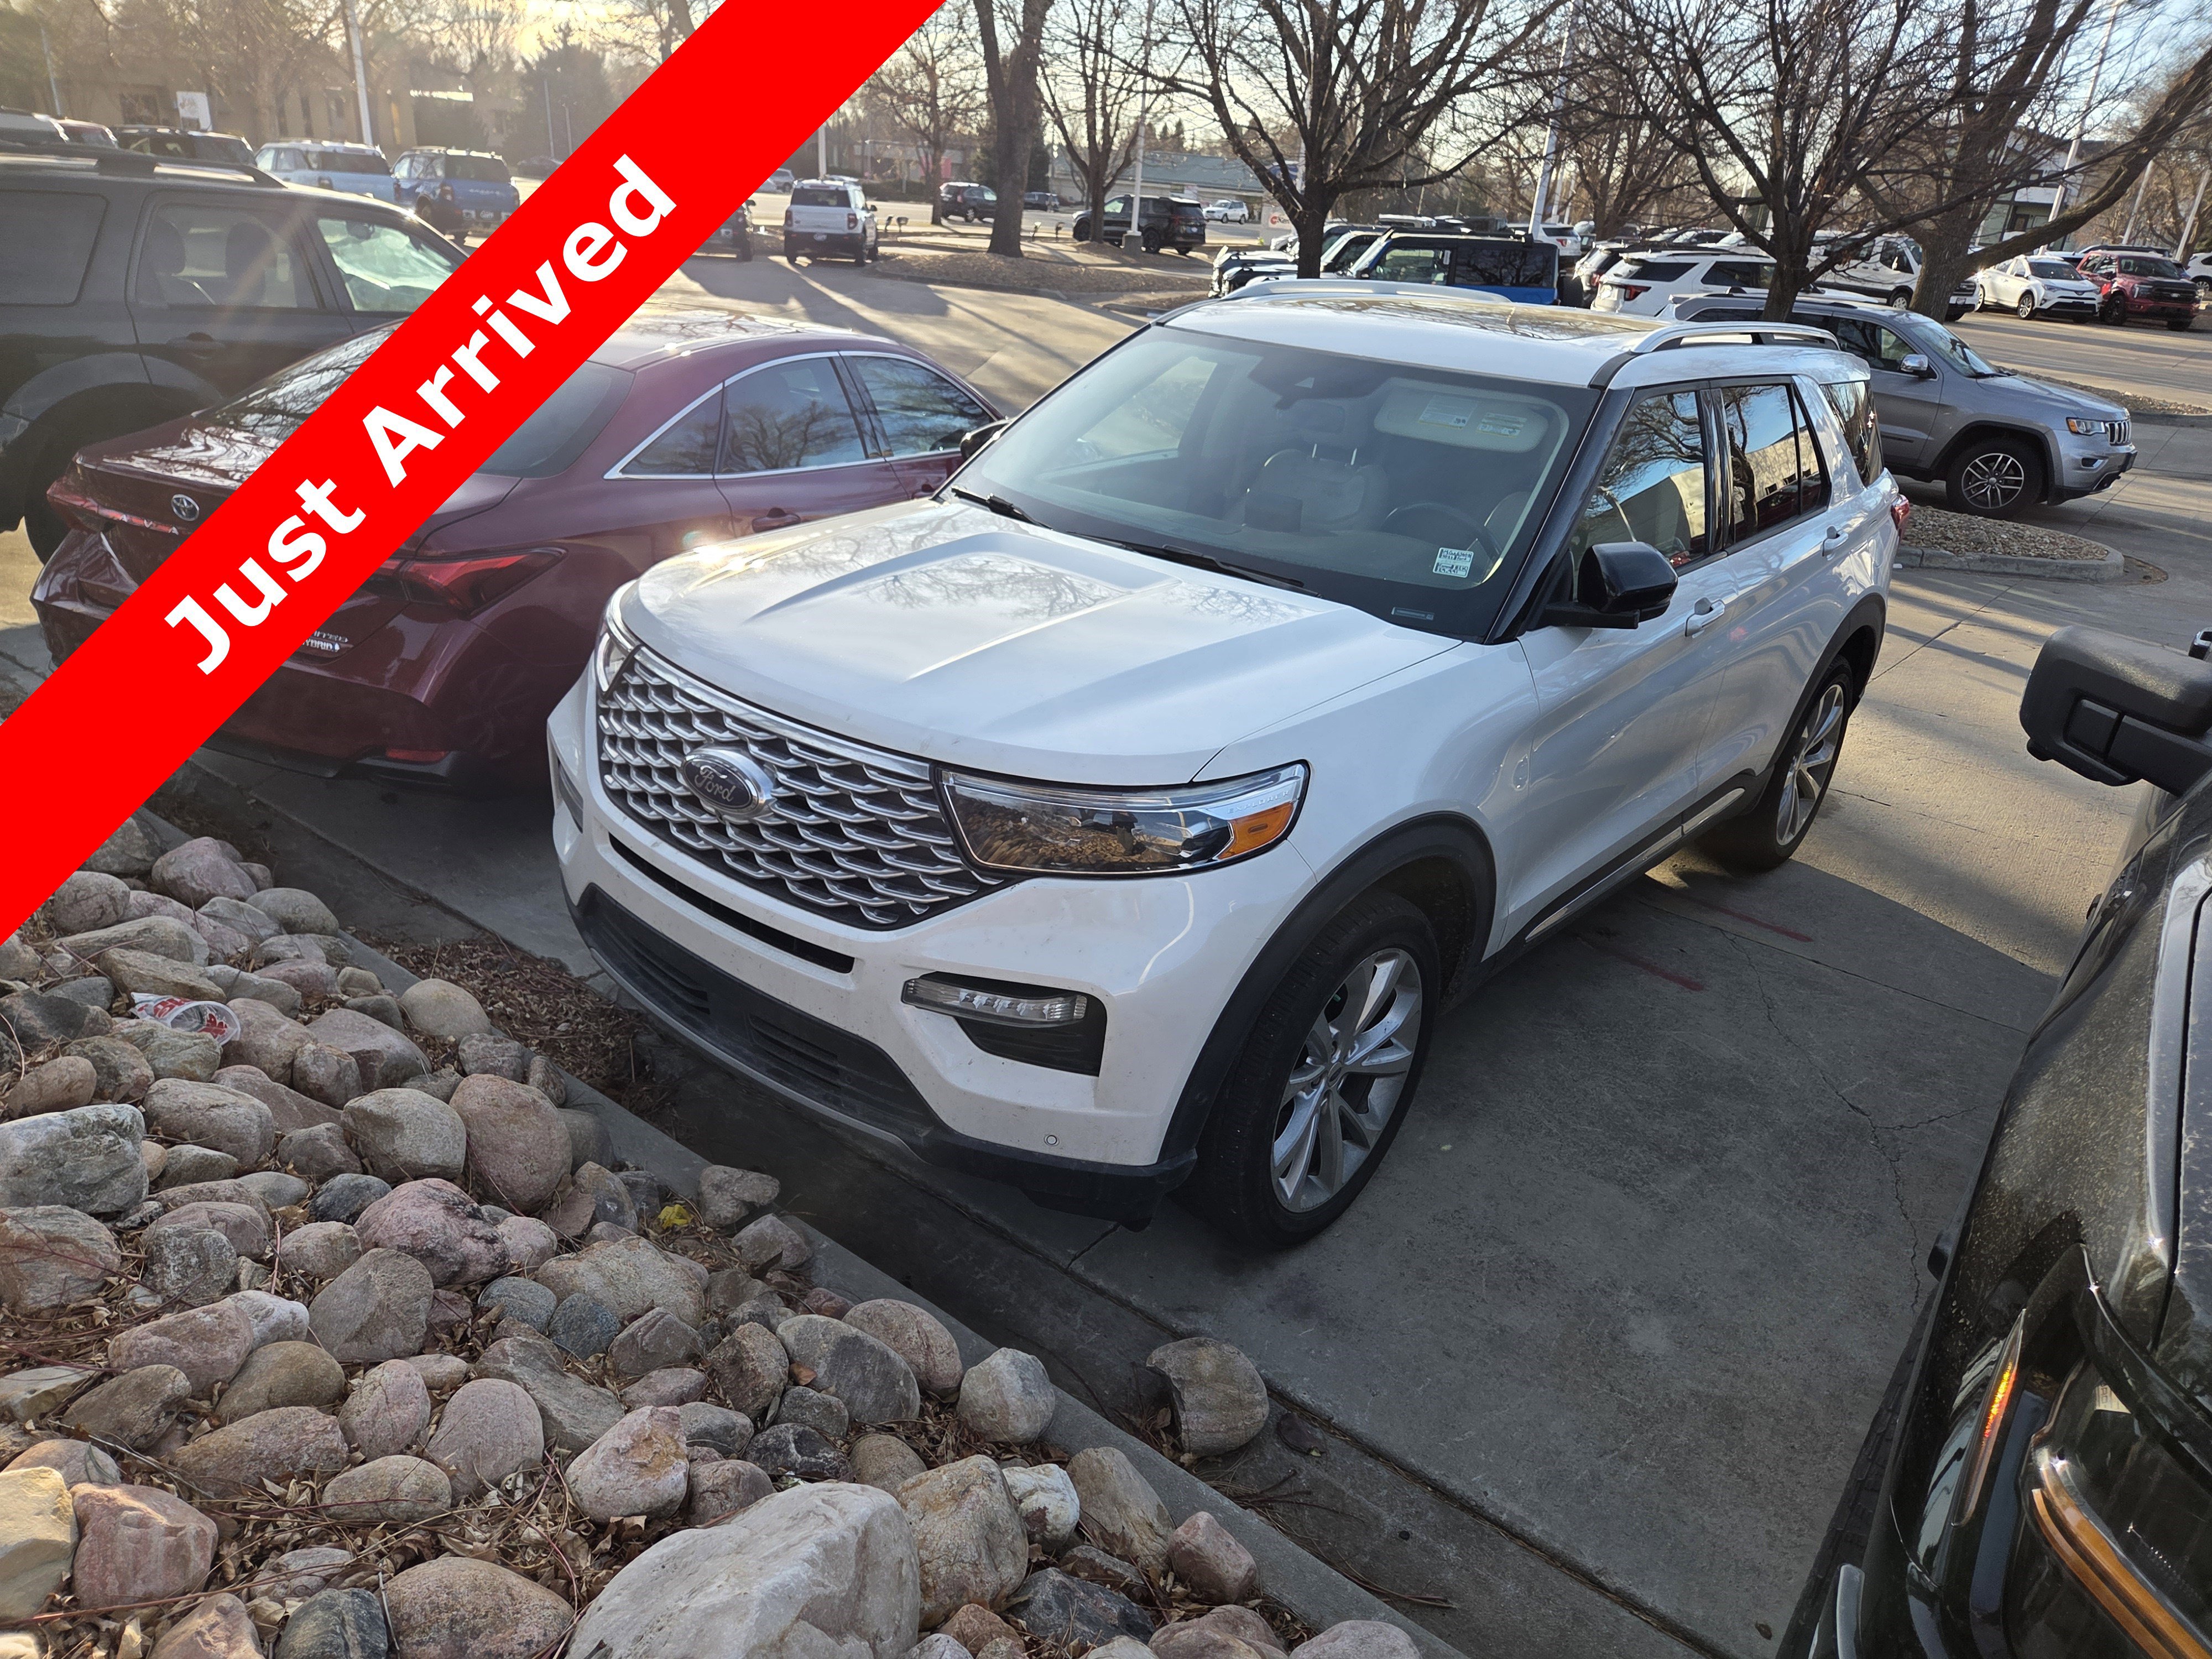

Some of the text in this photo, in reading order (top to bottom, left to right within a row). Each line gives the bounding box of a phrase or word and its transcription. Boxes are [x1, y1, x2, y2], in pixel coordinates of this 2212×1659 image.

[119, 514, 179, 535] AVA
[302, 638, 333, 650] YBRID
[694, 765, 737, 802] Ford
[1229, 790, 1288, 813] EXPLORER
